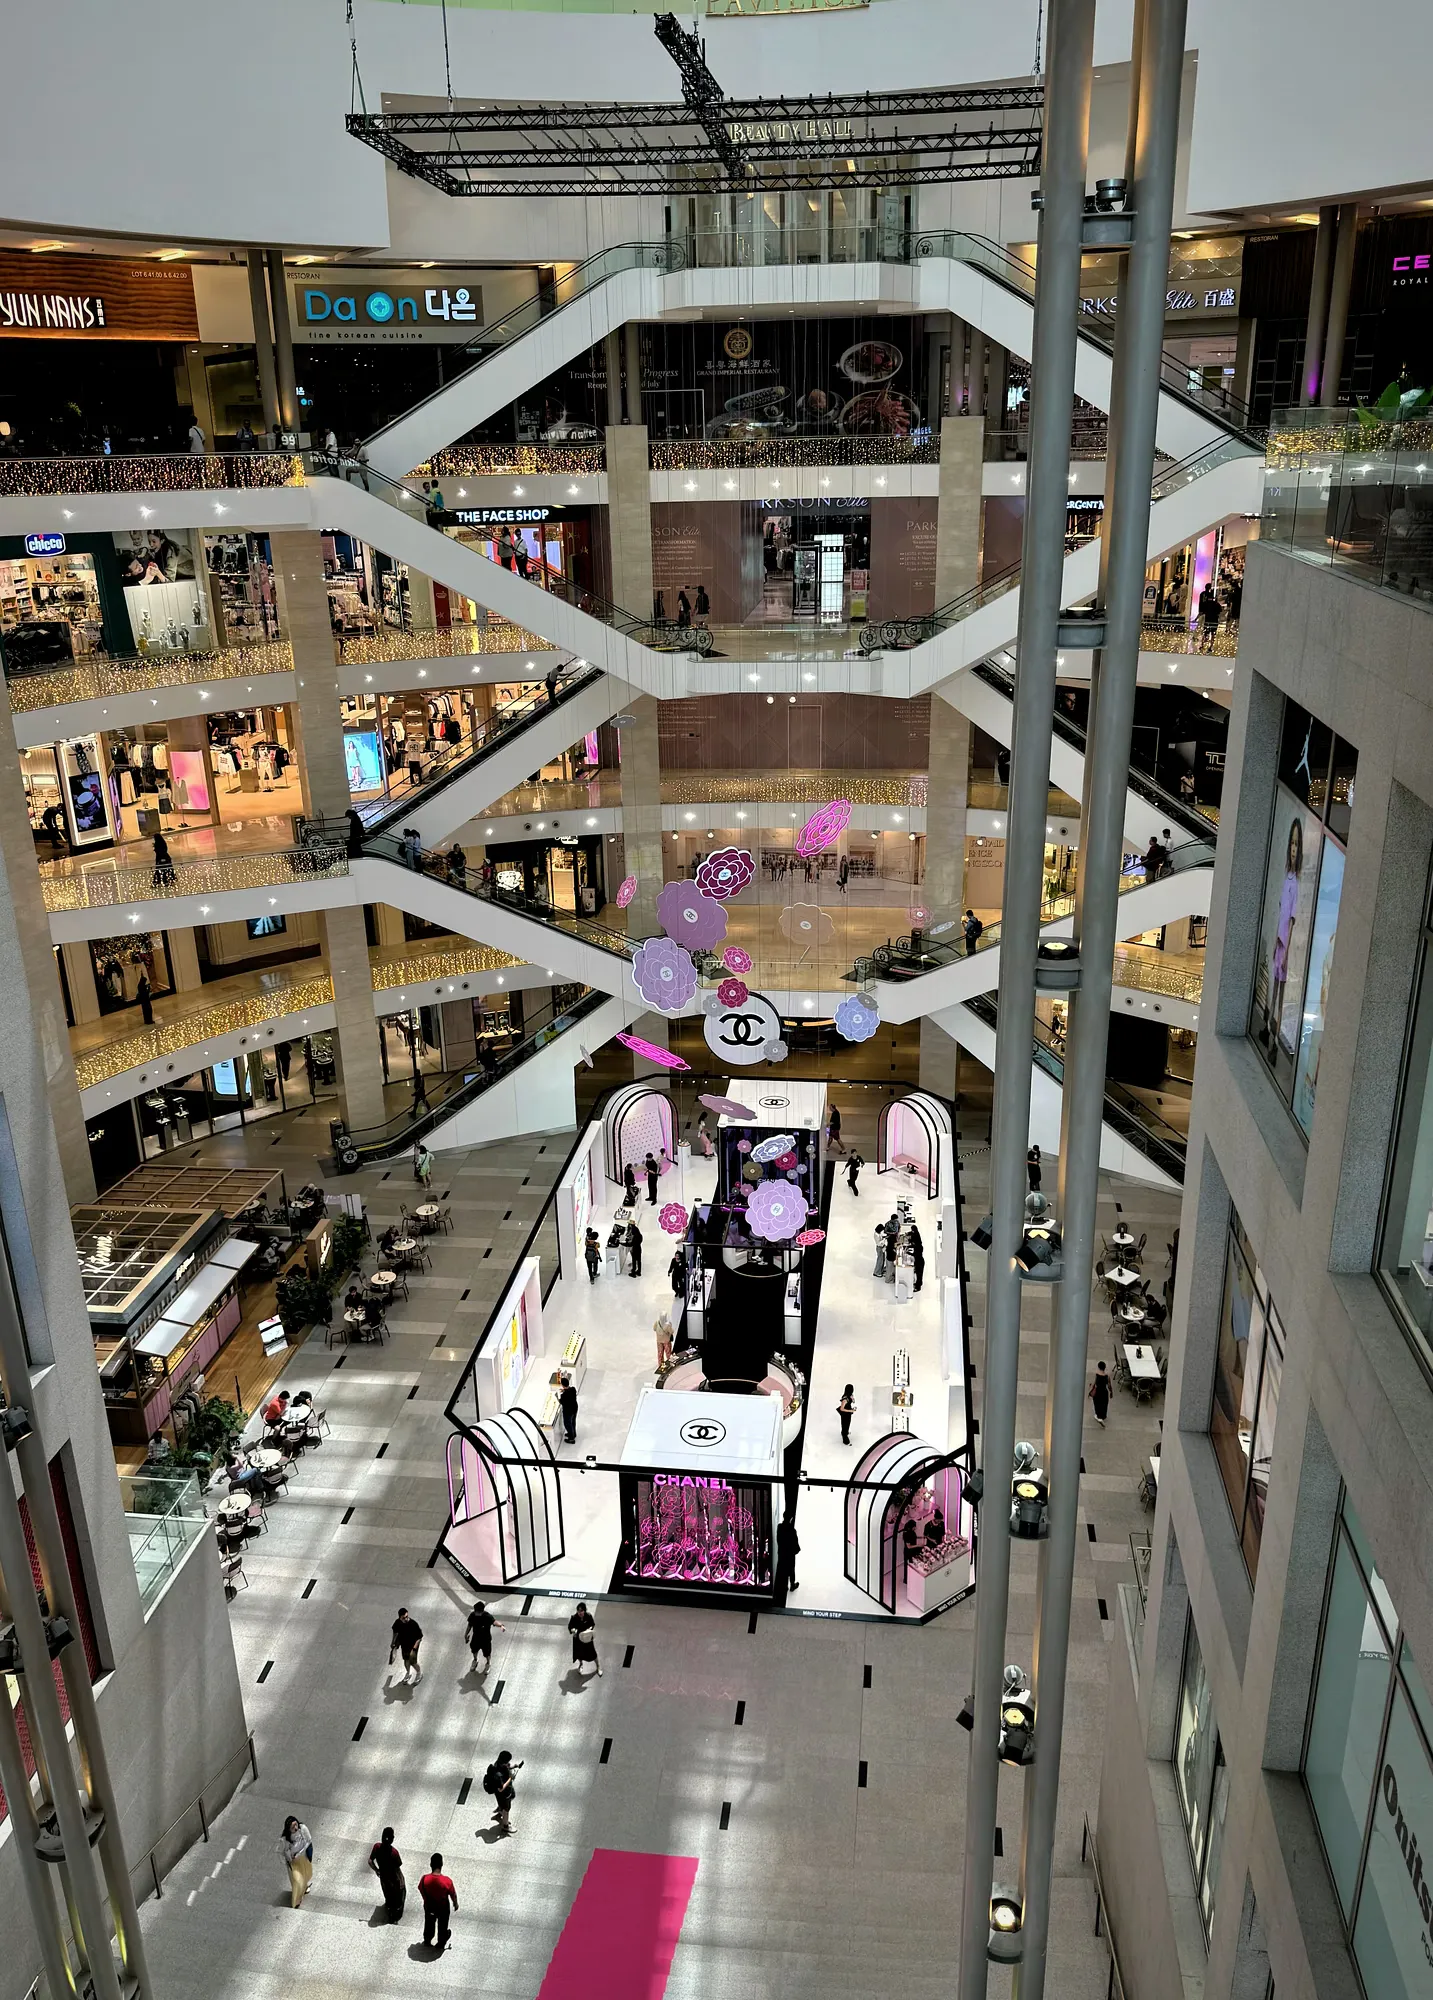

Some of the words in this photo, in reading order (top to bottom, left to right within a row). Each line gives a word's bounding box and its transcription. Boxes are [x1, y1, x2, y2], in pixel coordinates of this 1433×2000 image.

[729, 122, 801, 143] BEAUTY
[805, 119, 856, 139] HALL
[286, 272, 321, 280] RESTORAN
[1393, 277, 1428, 286] ROYAL
[1203, 288, 1235, 308] 百盛
[337, 331, 376, 339] korean
[456, 511, 481, 523] THE
[482, 510, 515, 522] FACE
[515, 508, 550, 521] SHOP
[28, 533, 63, 552] chicco
[653, 1473, 733, 1490] CHANEL
